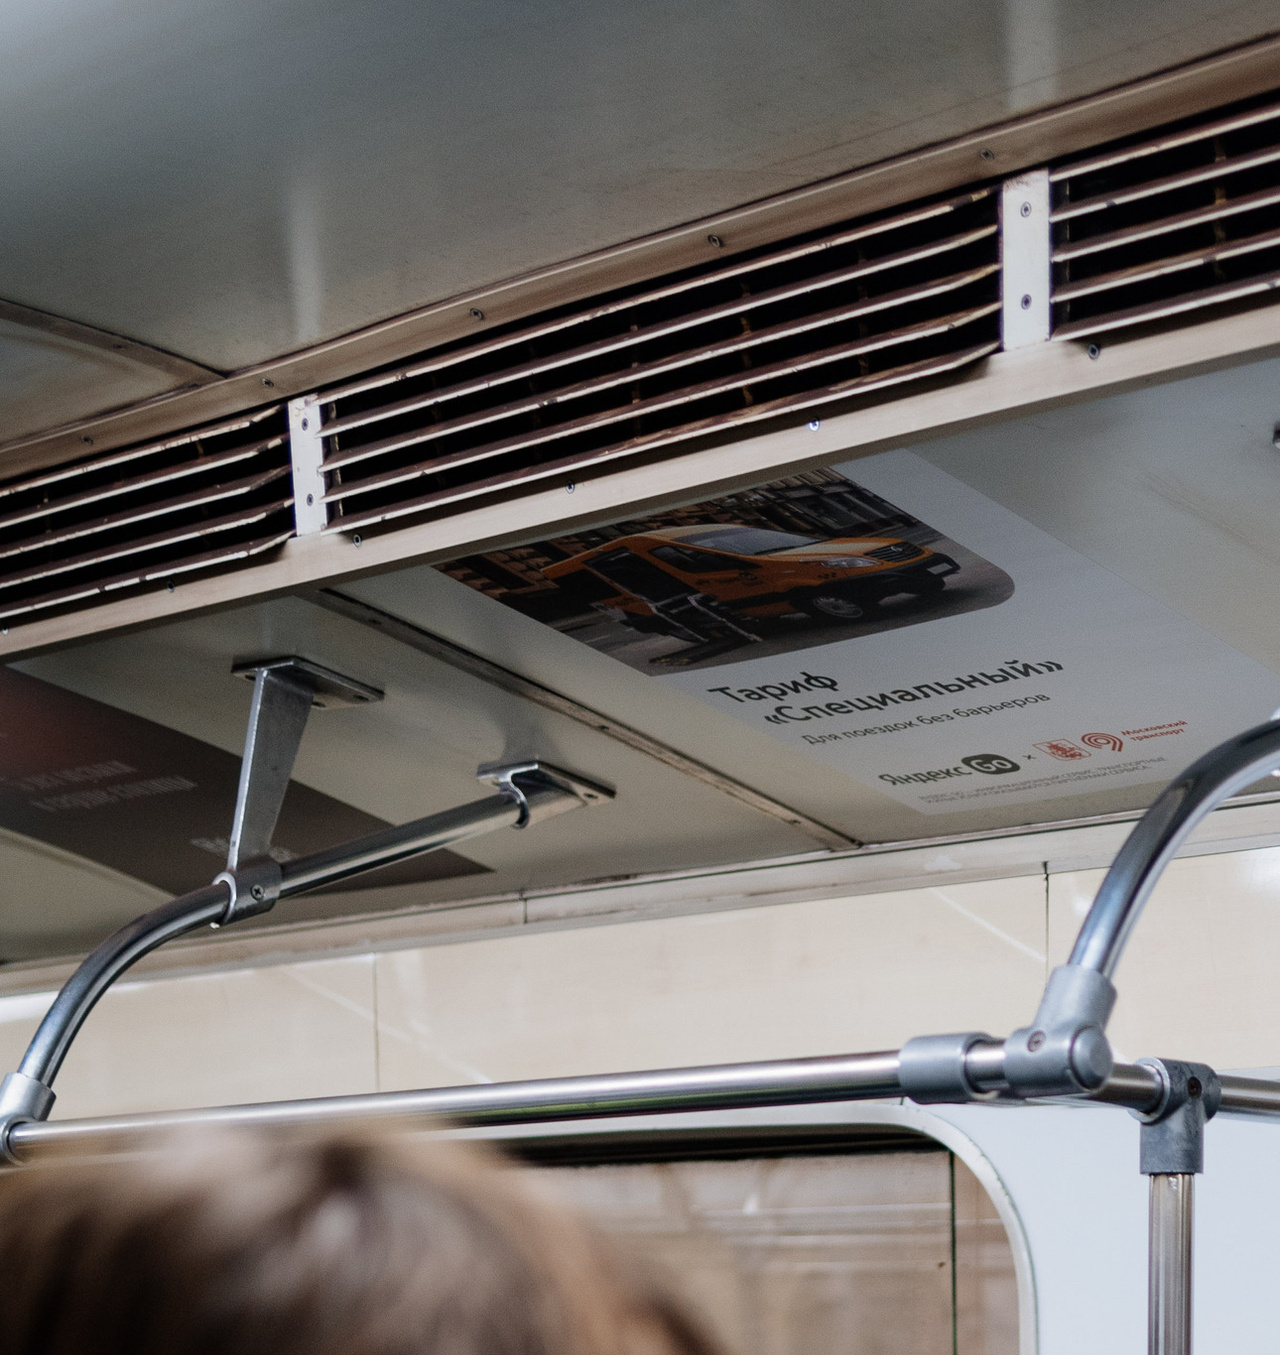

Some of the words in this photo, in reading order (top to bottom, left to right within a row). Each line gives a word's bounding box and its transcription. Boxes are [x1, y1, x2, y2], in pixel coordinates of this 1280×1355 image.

[706, 671, 839, 703] Тариф
[764, 659, 1064, 725] «Специальный»
[802, 732, 842, 745] Для
[841, 719, 920, 739] поездок
[916, 714, 954, 725] без
[952, 693, 1051, 718] барьеров
[1121, 720, 1188, 736] Московский
[1130, 728, 1185, 742] транспорт
[878, 766, 973, 786] Яндекс
[969, 758, 1013, 772] Go
